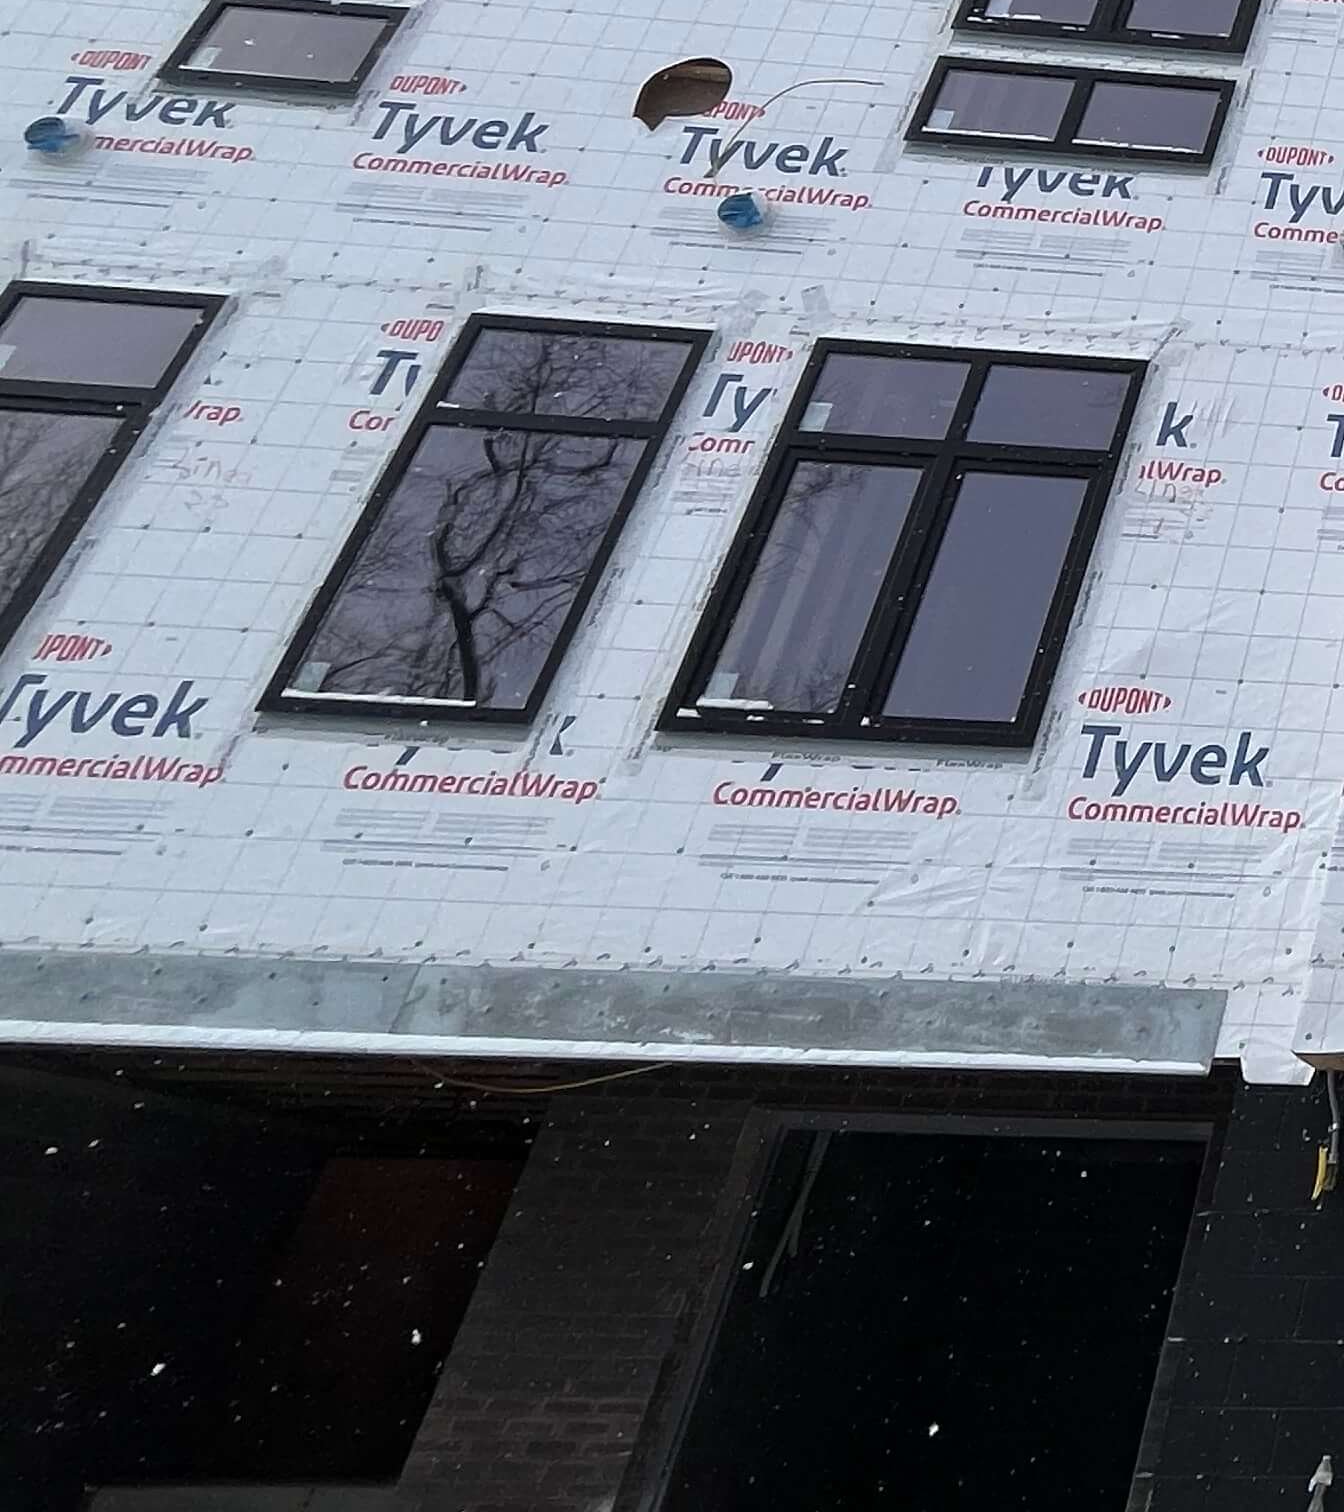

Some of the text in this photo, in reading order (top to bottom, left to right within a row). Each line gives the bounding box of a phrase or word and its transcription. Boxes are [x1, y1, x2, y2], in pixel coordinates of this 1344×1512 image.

[74, 50, 151, 70] DUPONT
[52, 76, 234, 128] Tyvek
[390, 76, 464, 96] DUPONT
[370, 100, 549, 153] Tyvek
[353, 152, 568, 187] CommercialWrap
[680, 126, 848, 179] Tyvek
[1262, 147, 1330, 166] DUPONT
[963, 199, 1164, 233] CommercialWrap
[1079, 687, 1171, 715] DUPONT
[1080, 724, 1272, 796] Tyvek
[343, 765, 597, 804] CommercialWrap
[713, 781, 957, 819] CommercialWrap
[1067, 796, 1302, 834] CommercialWrap
